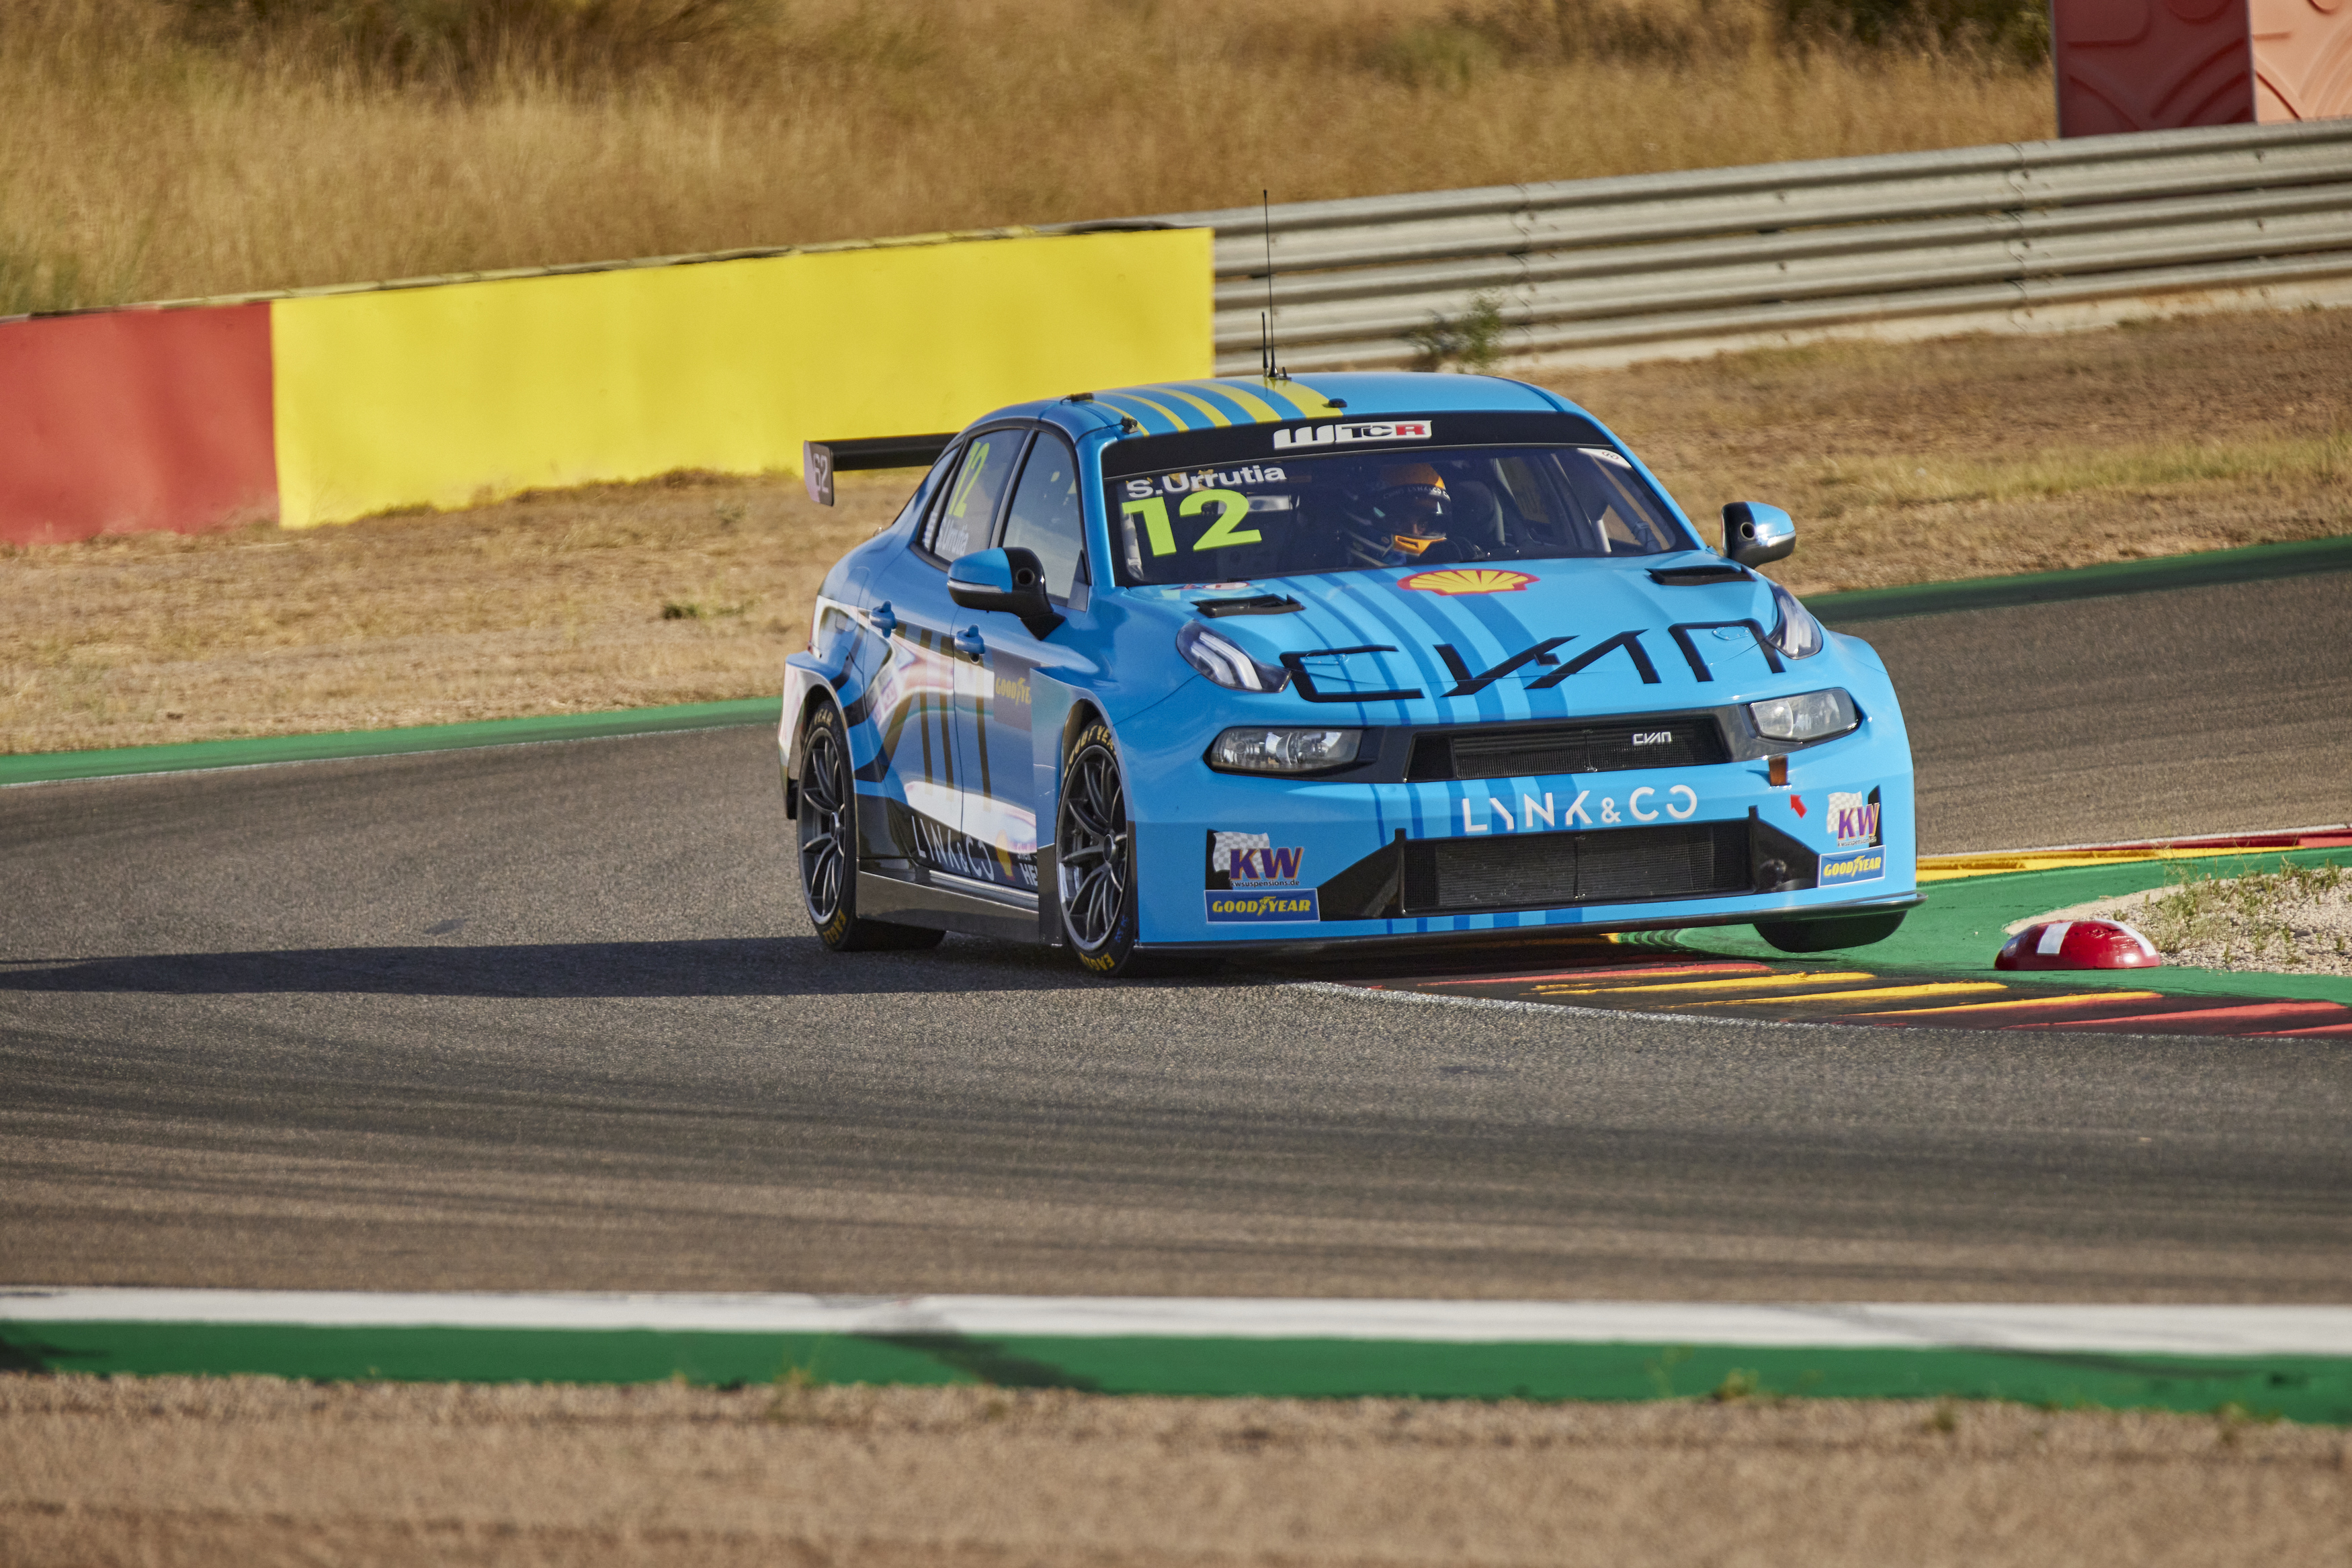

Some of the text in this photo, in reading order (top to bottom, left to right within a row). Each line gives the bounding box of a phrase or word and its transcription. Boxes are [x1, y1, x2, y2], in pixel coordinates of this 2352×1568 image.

[1273, 421, 1432, 449] WTCR
[948, 441, 990, 518] 12
[1126, 465, 1287, 498] S.Urrutia
[1122, 489, 1262, 558] 12
[1837, 802, 1880, 840] KW
[1229, 846, 1304, 880] KW
[1823, 856, 1882, 877] GOODYEAR
[1230, 879, 1300, 887] kwsuspensions.de
[1212, 897, 1311, 915] GOODYEAR
